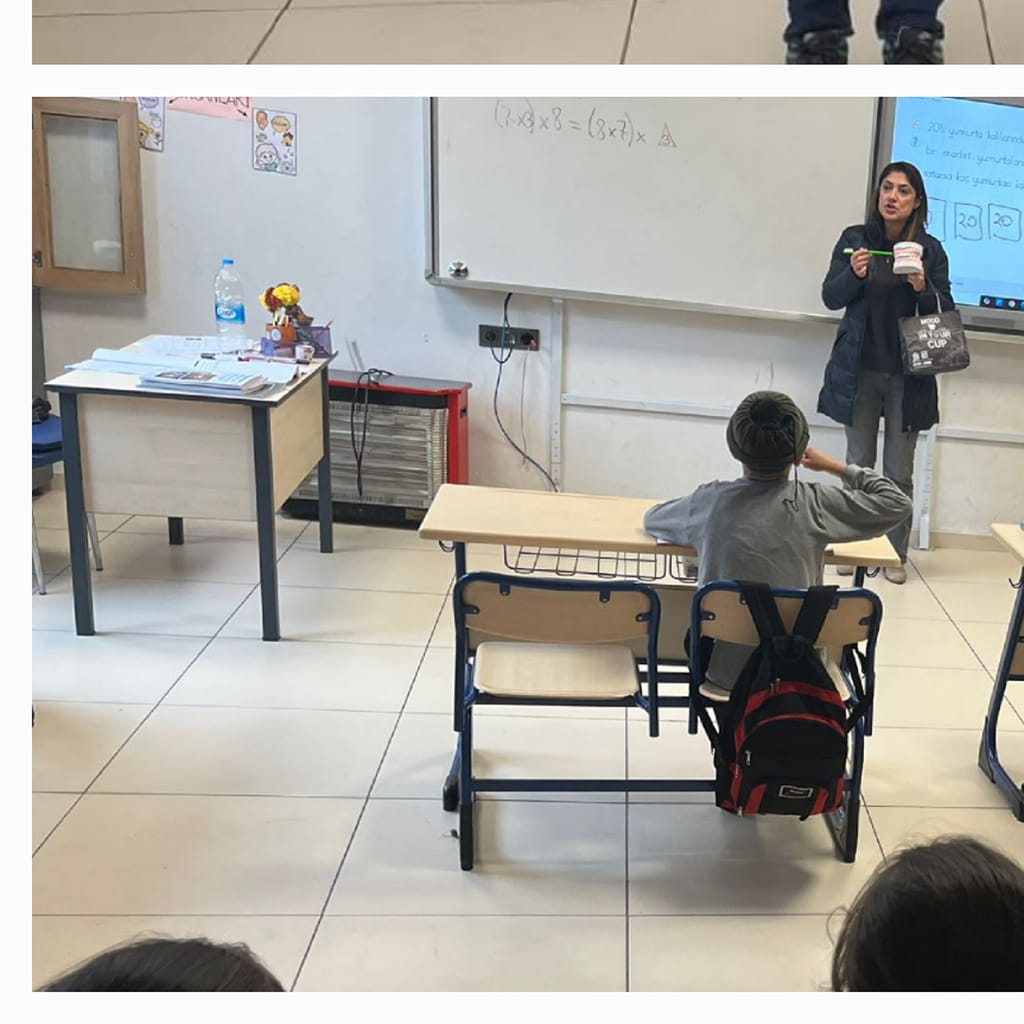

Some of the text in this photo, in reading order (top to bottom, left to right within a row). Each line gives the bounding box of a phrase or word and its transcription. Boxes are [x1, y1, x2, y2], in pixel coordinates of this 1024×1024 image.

[958, 212, 978, 229] 20
[993, 212, 1014, 228] 20
[927, 339, 948, 349] CUP
